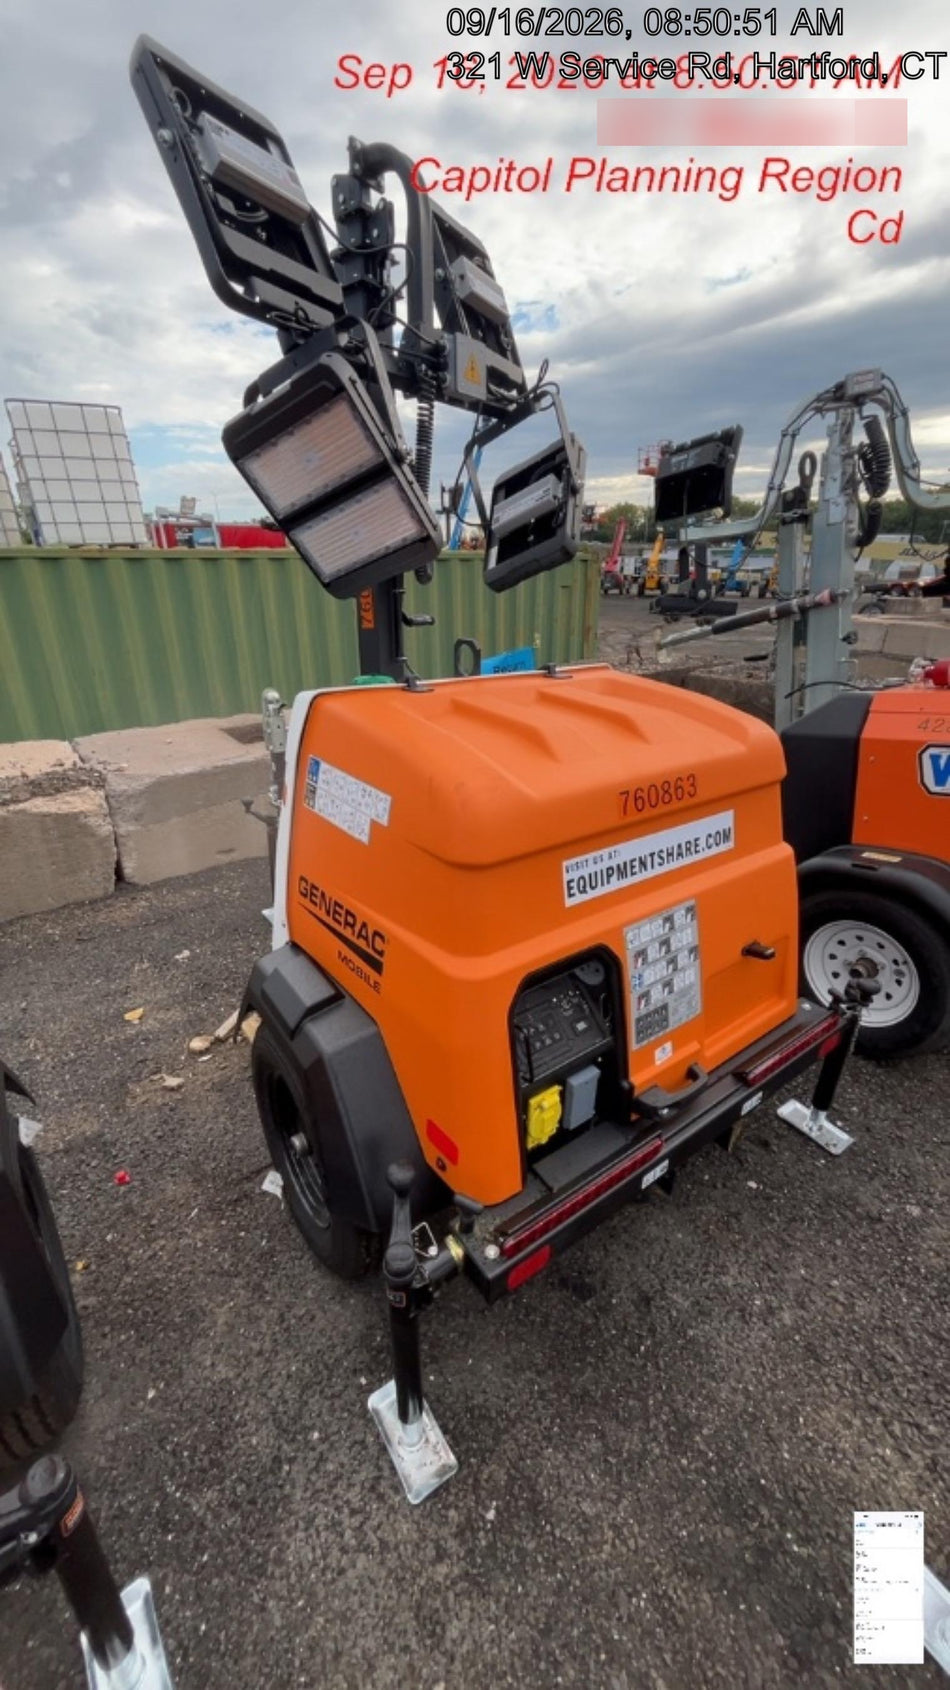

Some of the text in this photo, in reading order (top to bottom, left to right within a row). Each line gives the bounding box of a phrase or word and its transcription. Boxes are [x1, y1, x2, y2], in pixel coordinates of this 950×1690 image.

[619, 773, 698, 817] 760863
[566, 826, 732, 898] EQUIPMENTSHARE.COM
[298, 875, 387, 958] GENERAC
[338, 950, 382, 995] MOBILE
